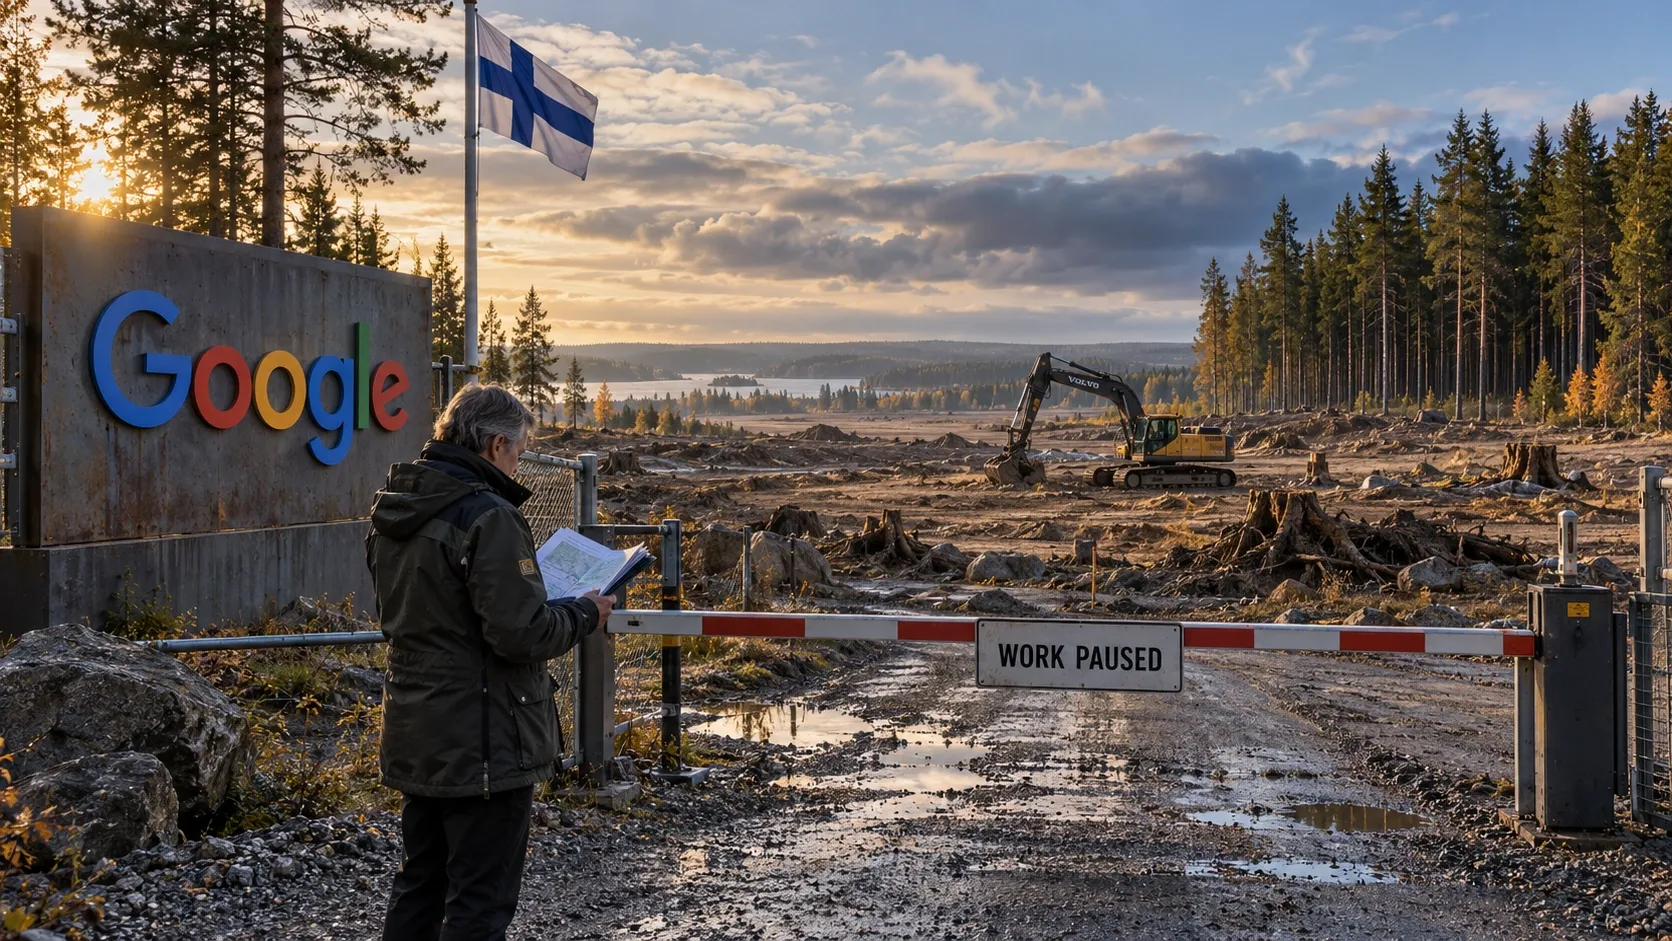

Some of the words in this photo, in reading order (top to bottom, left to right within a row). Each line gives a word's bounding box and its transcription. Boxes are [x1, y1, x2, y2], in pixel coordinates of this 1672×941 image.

[90, 289, 410, 466] Google
[1068, 375, 1100, 389] VOLVO
[998, 643, 1065, 669] WORK
[1076, 645, 1162, 672] PAUSED
